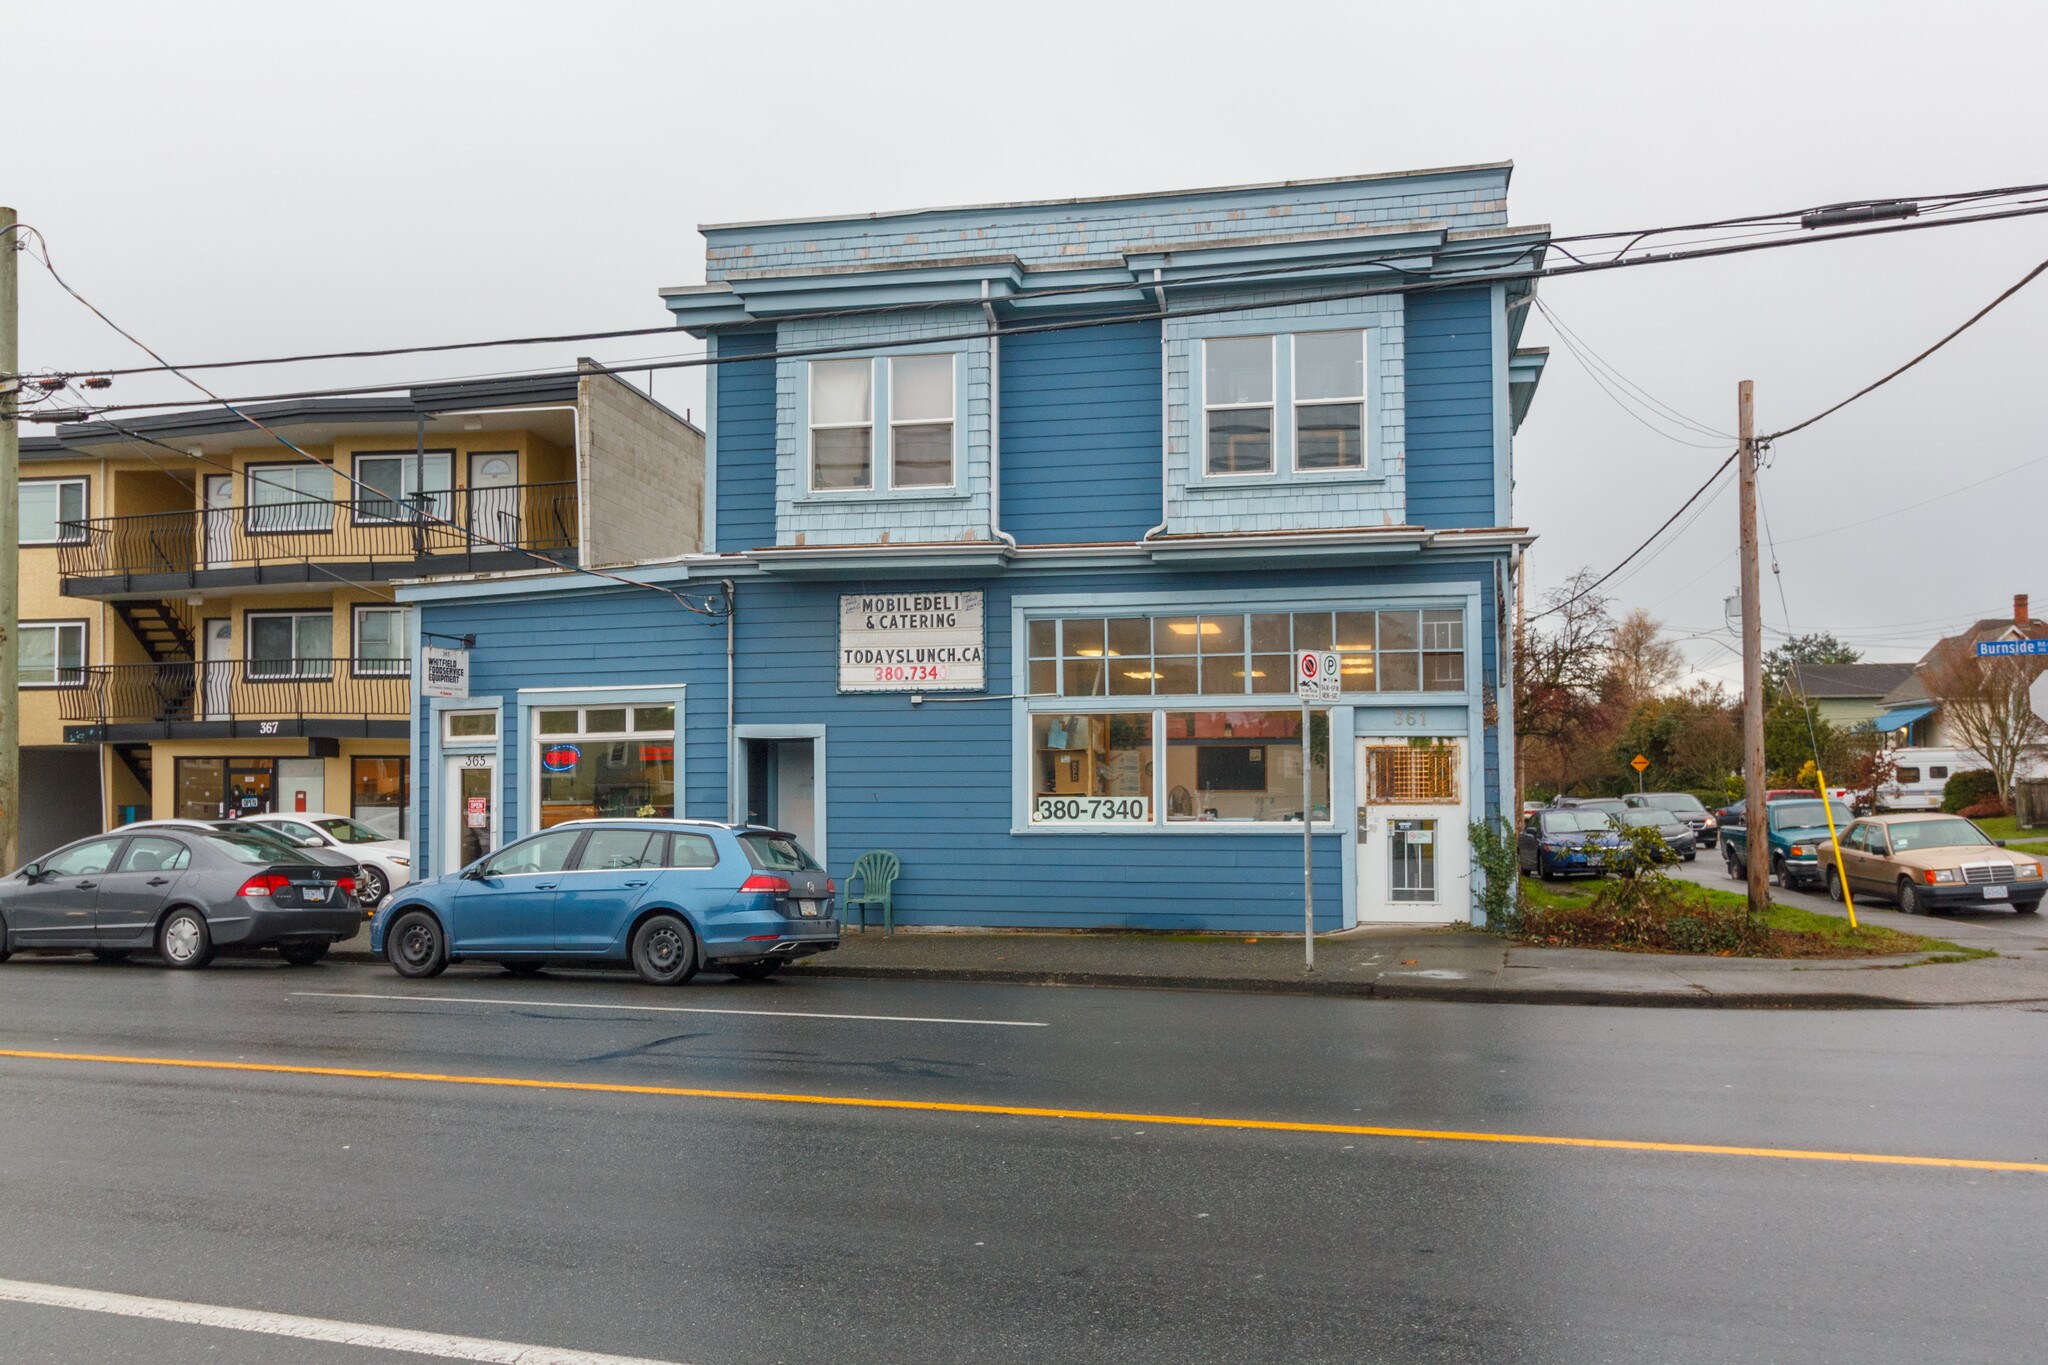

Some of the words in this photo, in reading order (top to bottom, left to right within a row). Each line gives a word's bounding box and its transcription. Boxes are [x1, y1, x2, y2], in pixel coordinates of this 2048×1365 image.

[862, 596, 959, 612] MOBILEDELI
[866, 615, 875, 629] &
[879, 613, 956, 629] CATERING
[1980, 641, 2035, 655] Burnside
[428, 657, 457, 668] WHITFIELD
[844, 647, 981, 664] TODAYSLUNCH.CA
[428, 665, 464, 677] FOODSERVICE
[428, 673, 460, 684] EQUIPMENT
[1391, 708, 1427, 727] 361
[260, 721, 279, 734] 367
[465, 755, 486, 767] 365
[545, 751, 578, 765] OPEN
[243, 799, 257, 807] OPEN
[1039, 799, 1143, 820] 380-7340
